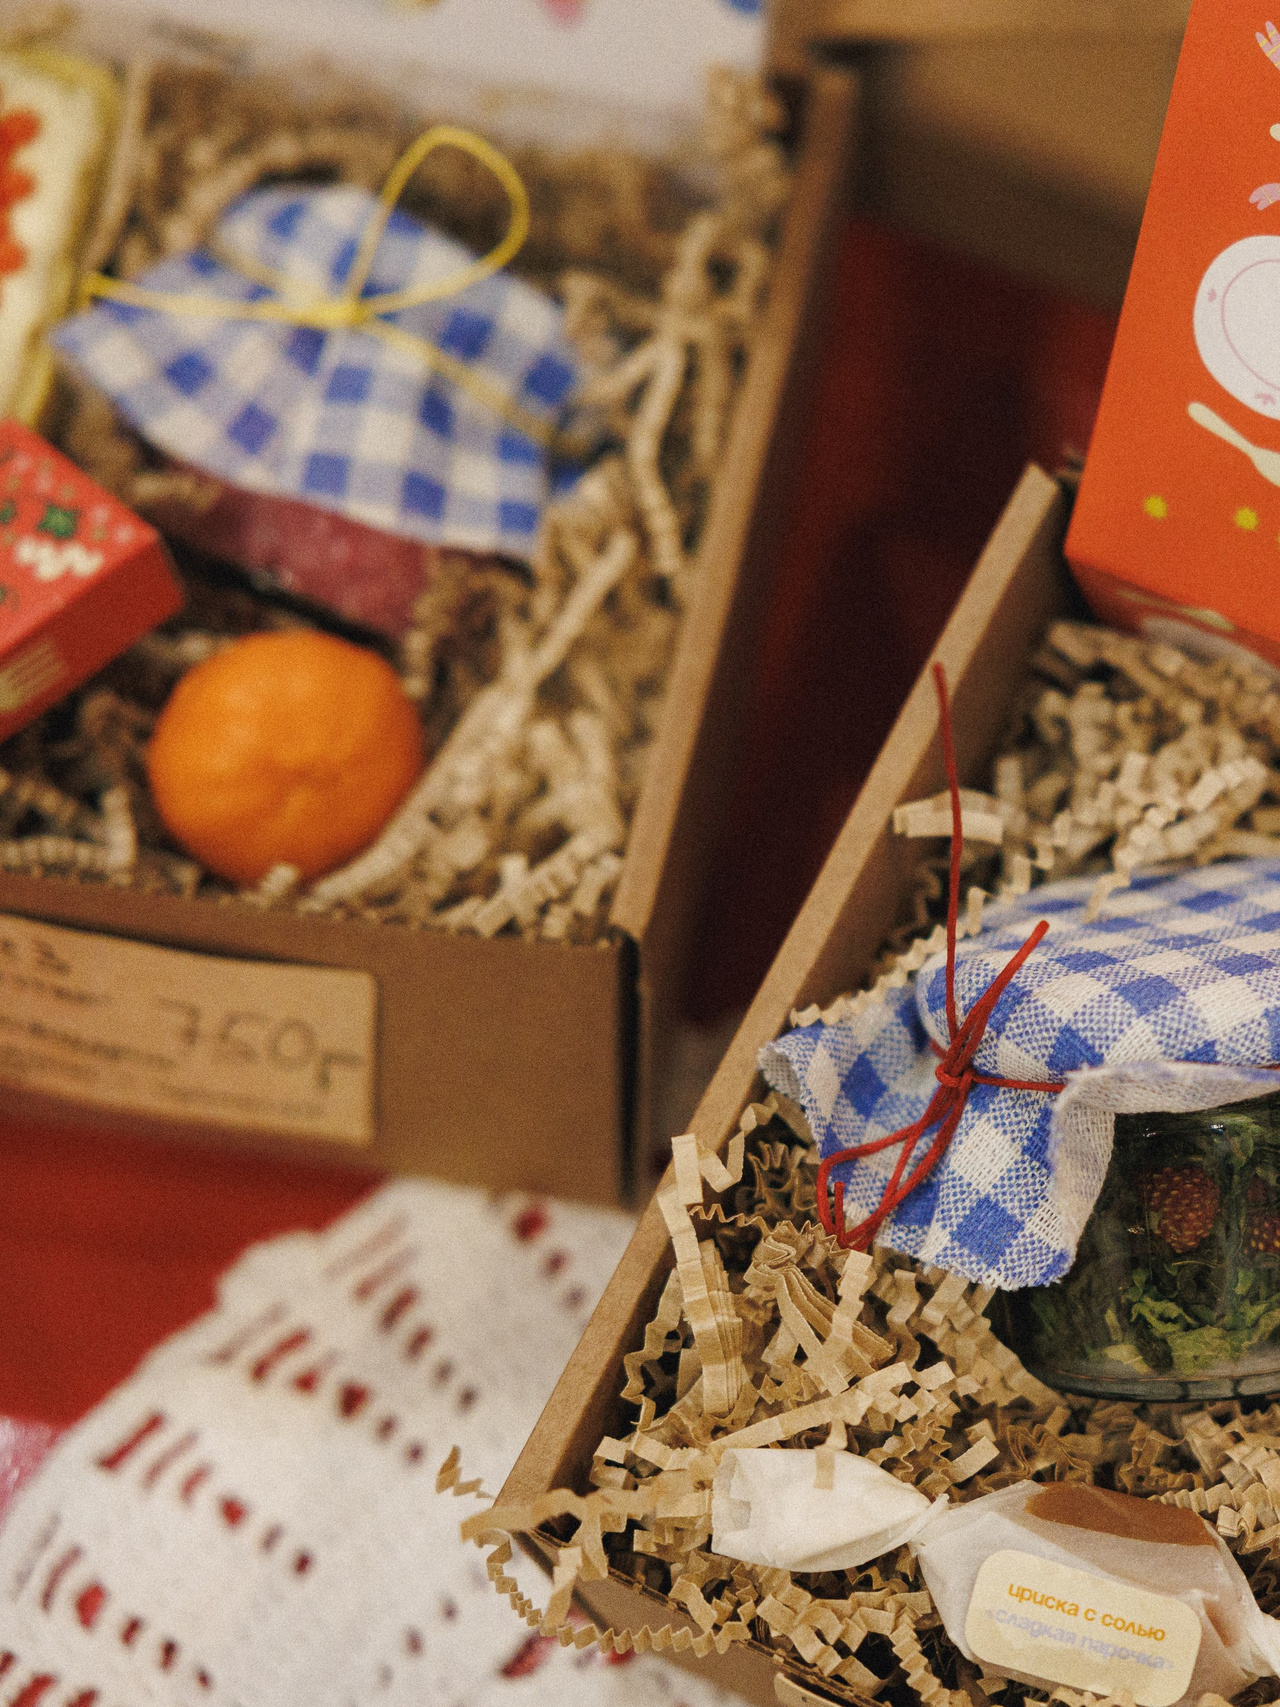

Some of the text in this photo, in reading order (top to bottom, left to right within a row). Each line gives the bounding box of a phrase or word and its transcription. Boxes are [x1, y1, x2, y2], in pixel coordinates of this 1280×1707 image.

[1008, 1583, 1166, 1642] ириска с солью
